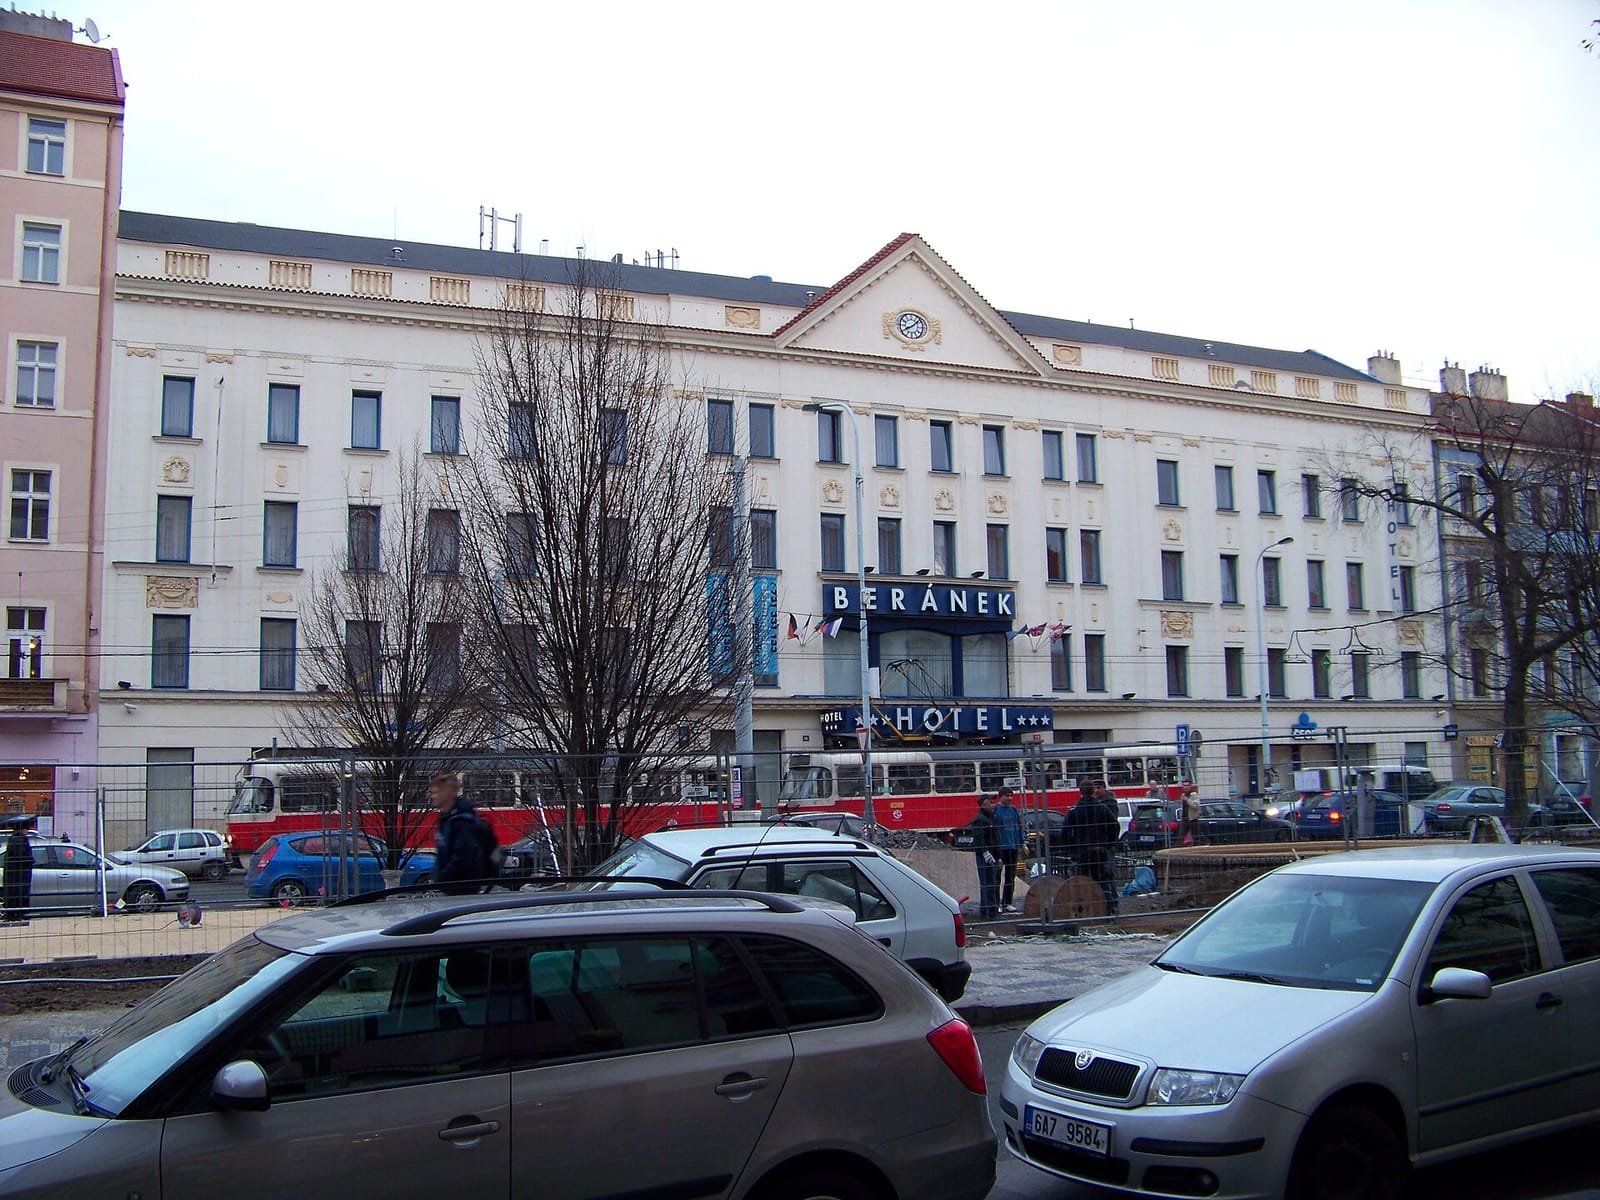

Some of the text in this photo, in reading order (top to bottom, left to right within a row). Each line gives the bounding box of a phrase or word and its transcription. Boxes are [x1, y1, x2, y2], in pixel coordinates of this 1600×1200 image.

[1387, 500, 1400, 601] HOTEL
[833, 583, 1012, 615] BERÁNEK
[820, 711, 843, 722] HOTEL
[896, 707, 1013, 731] HOTEL
[1034, 1113, 1058, 1137] 6A7
[1066, 1122, 1101, 1149] 9584
